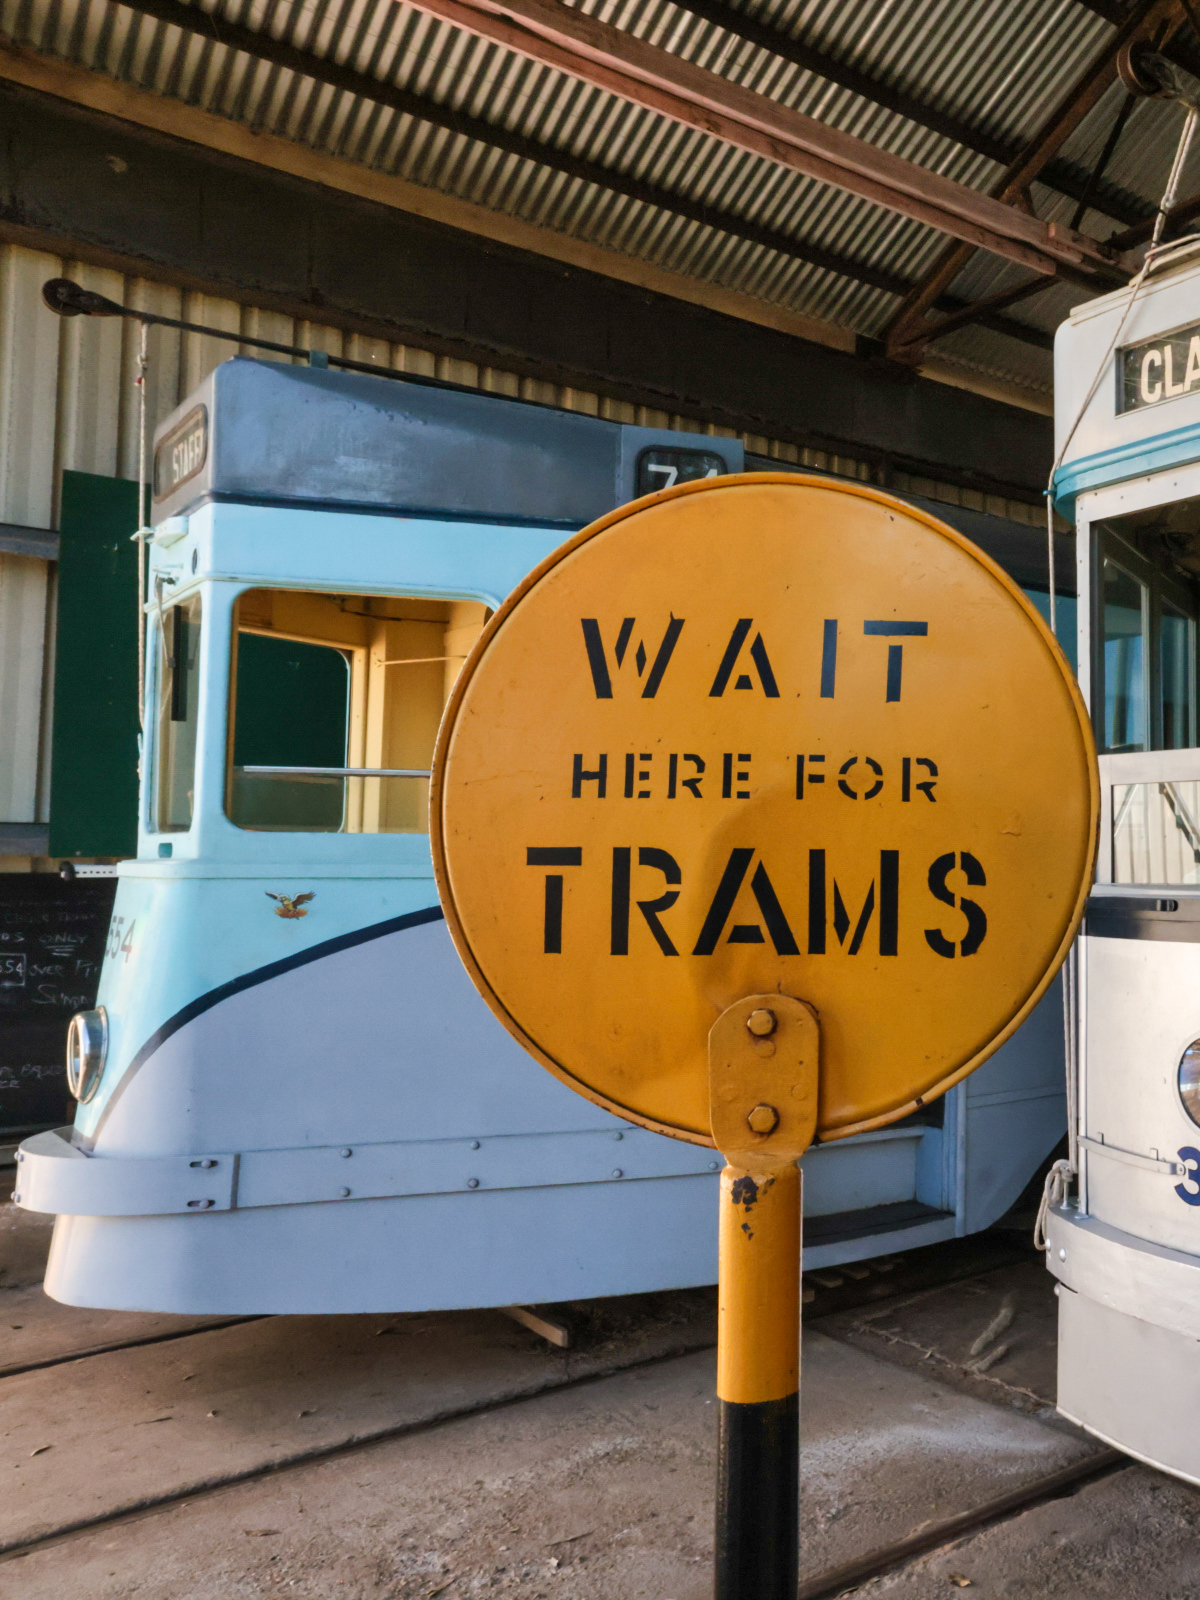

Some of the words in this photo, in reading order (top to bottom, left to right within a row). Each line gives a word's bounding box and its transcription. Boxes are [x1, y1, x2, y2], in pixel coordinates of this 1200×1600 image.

[647, 463, 718, 489] 7
[581, 614, 929, 702] WAIT
[571, 752, 752, 799] HERE
[795, 754, 939, 802] FOR
[526, 846, 988, 959] TRAMS
[31, 984, 92, 1009] SUNDA
